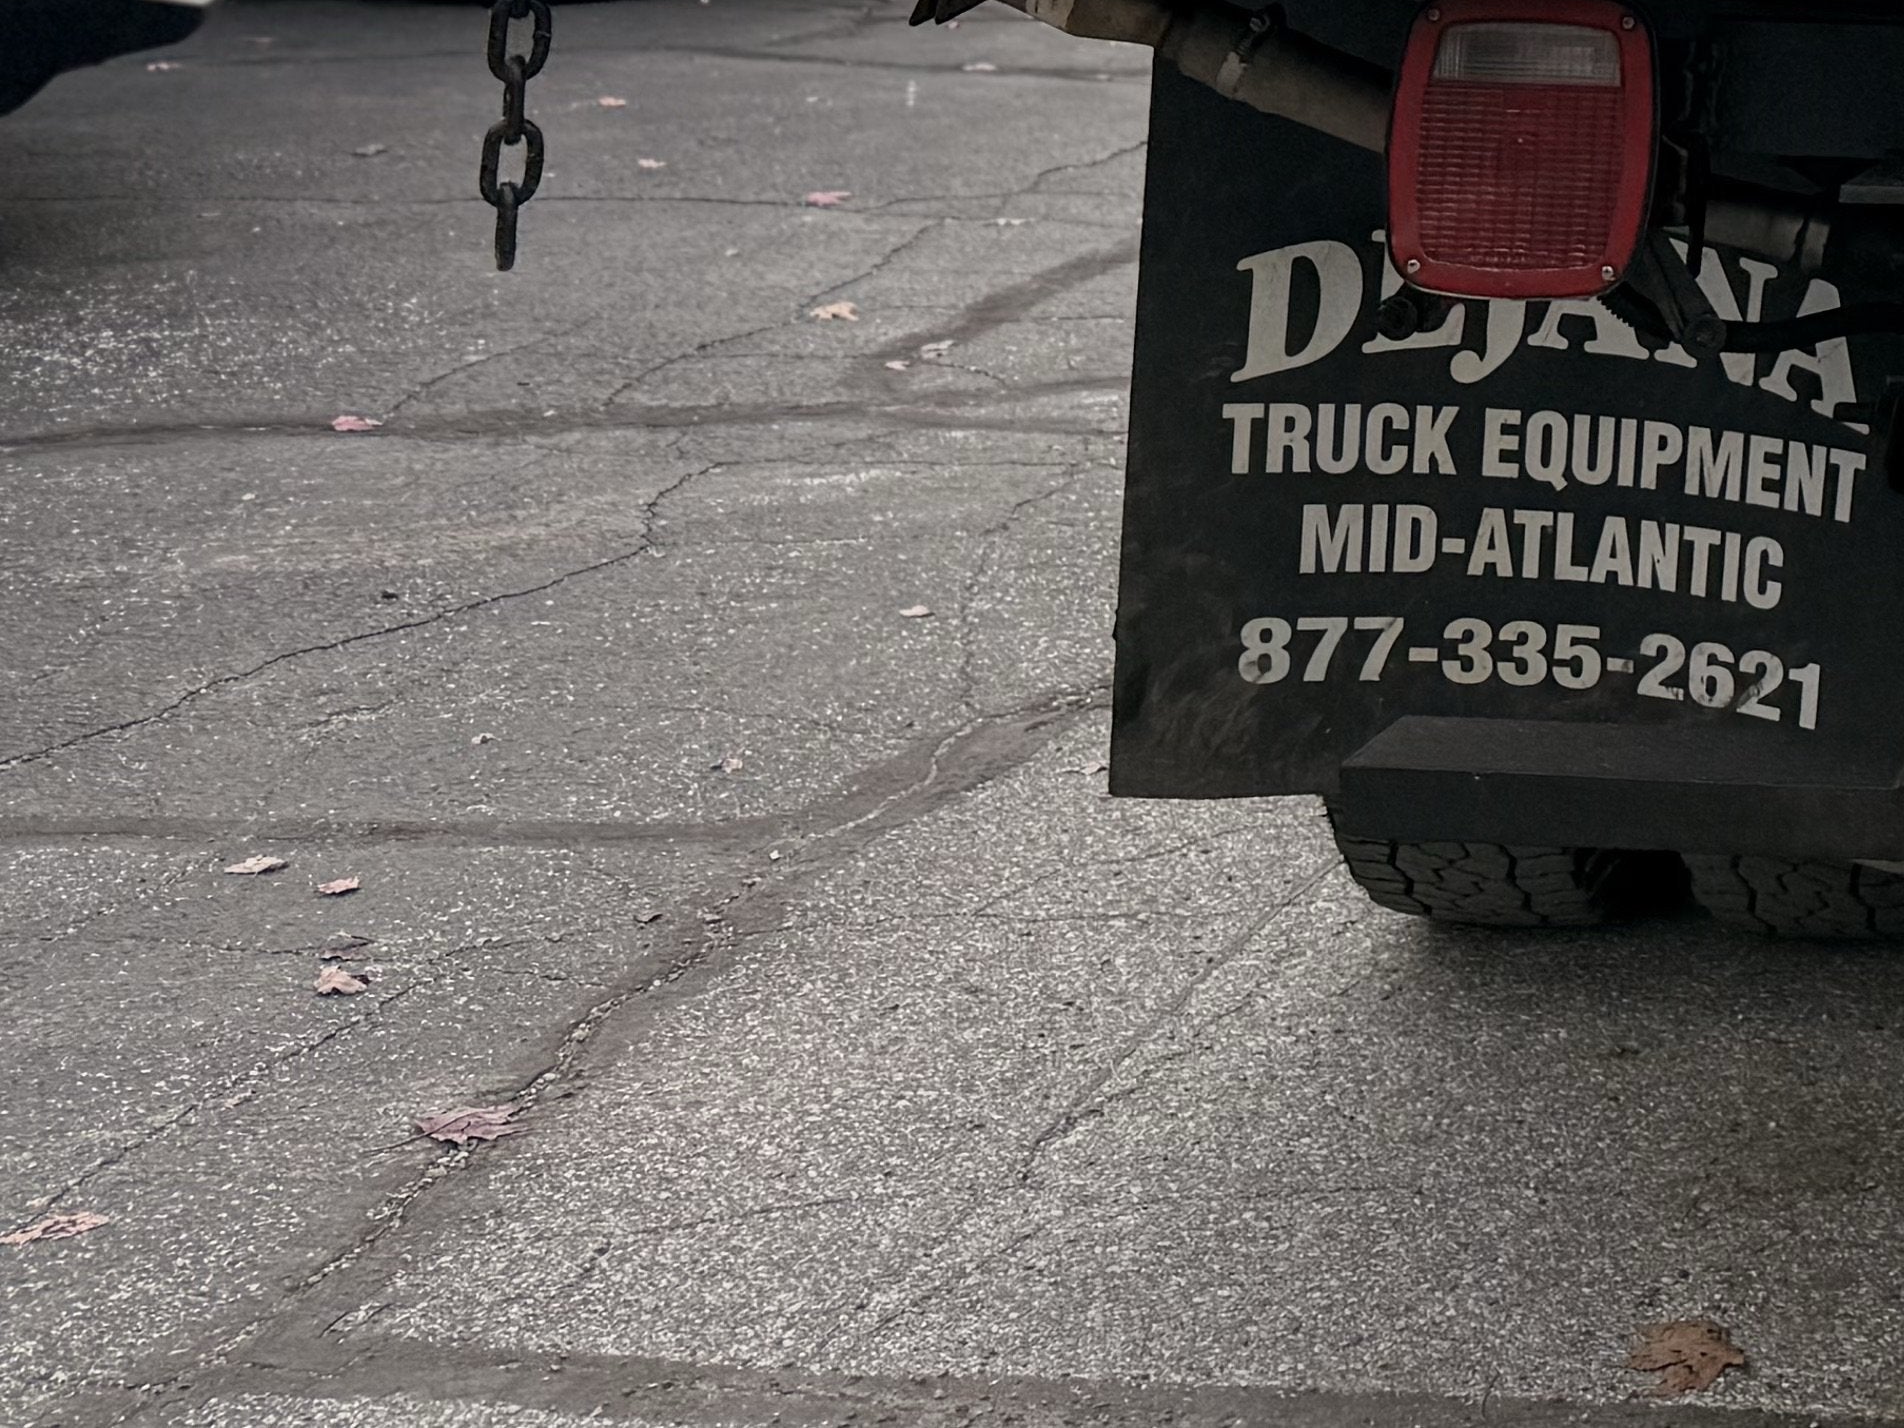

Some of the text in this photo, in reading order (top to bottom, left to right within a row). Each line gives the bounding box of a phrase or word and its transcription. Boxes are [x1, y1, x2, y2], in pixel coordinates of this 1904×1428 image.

[1221, 402, 1867, 524] TRUCK EQUIPMENT
[1298, 504, 1784, 610] MID-ATLANTIC
[1237, 616, 1822, 731] 877-335-2621
